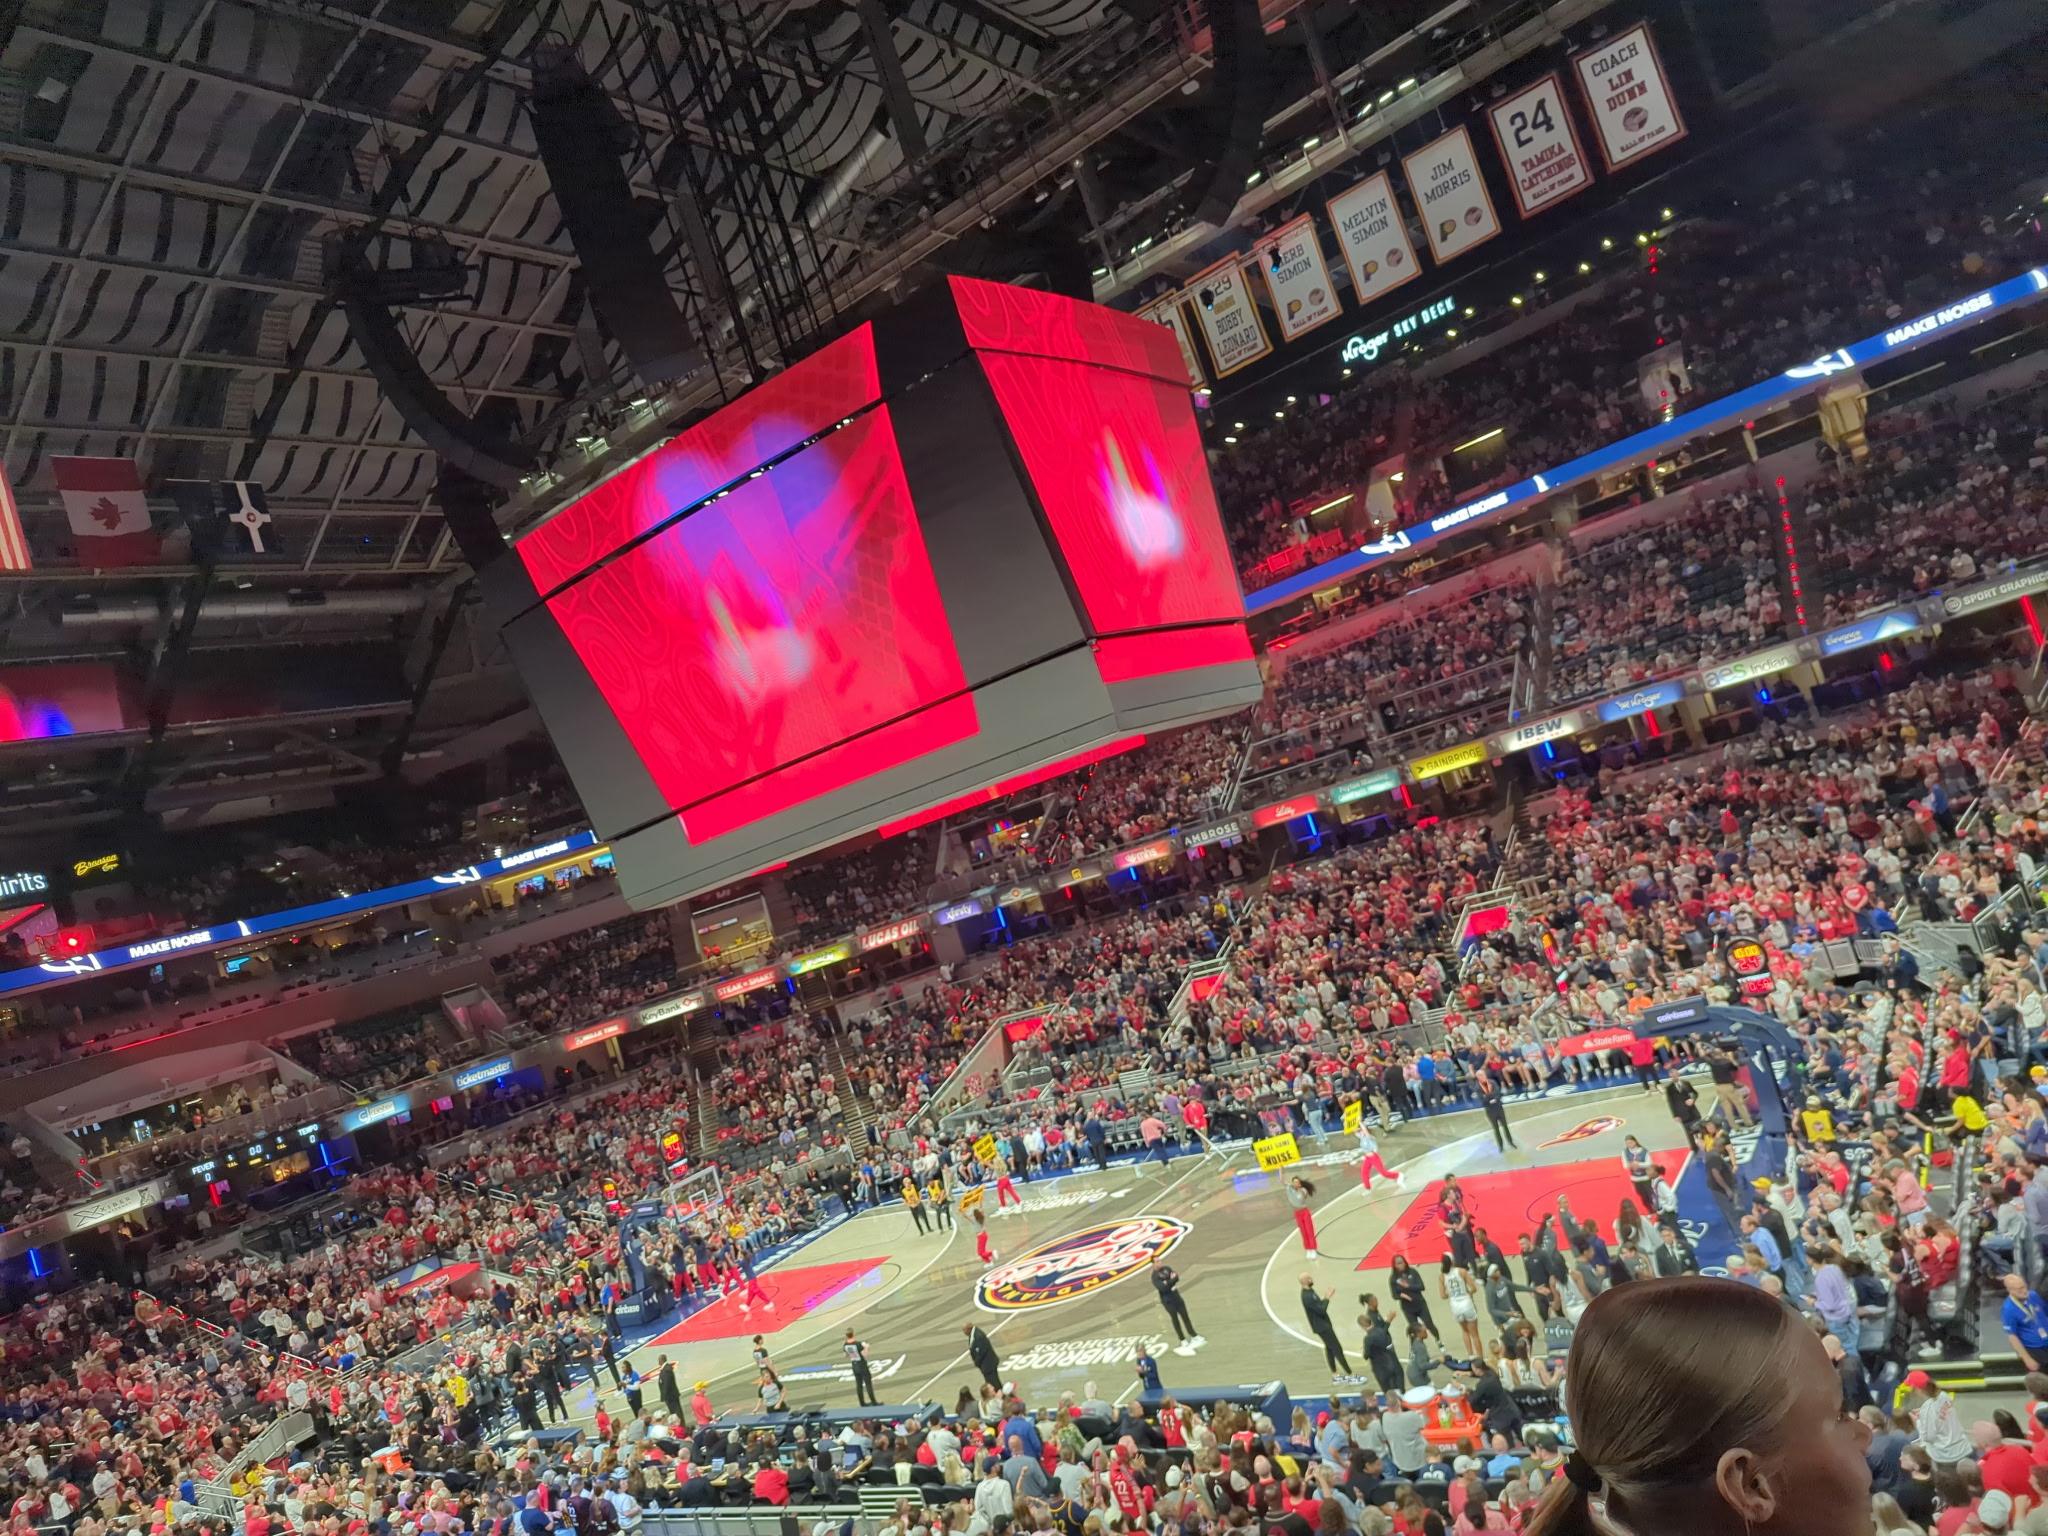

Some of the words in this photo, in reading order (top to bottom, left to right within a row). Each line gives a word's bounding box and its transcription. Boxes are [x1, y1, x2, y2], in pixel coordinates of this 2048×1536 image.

[1590, 41, 1640, 77] COACH
[1608, 68, 1634, 91] LIN
[1606, 80, 1648, 112] DUNN
[1509, 98, 1555, 148] 24
[1430, 158, 1455, 181] JIM
[1521, 142, 1566, 172] TAMIKA
[1423, 169, 1471, 204] MORRIS
[1341, 198, 1388, 232] MELVIN
[1351, 216, 1389, 245] SIMON
[1276, 256, 1312, 284] SIMON
[1215, 308, 1244, 336] BOBBY
[1342, 330, 1390, 362] Kroger
[1393, 314, 1418, 338] SKY
[1421, 296, 1456, 324] DECK
[1885, 314, 1938, 346] MAKE
[1939, 292, 1993, 326] NOISE
[1217, 325, 1258, 357] LEONARD
[1963, 587, 1998, 606] SPORT
[1704, 662, 1747, 689] aes
[1516, 717, 1563, 742] IBEW
[1426, 747, 1483, 771] GAINBRIDGE
[1184, 821, 1240, 847] AMBROSE
[0, 873, 46, 897] irits
[129, 939, 170, 959] MAKE
[171, 931, 212, 949] NOISE
[862, 926, 899, 949] LUCAS
[900, 919, 920, 937] OIL
[641, 1003, 682, 1022] KeyBank
[455, 1060, 511, 1086] ticketmaster
[192, 1161, 215, 1176] FEVER
[1265, 1150, 1293, 1166] NOISE
